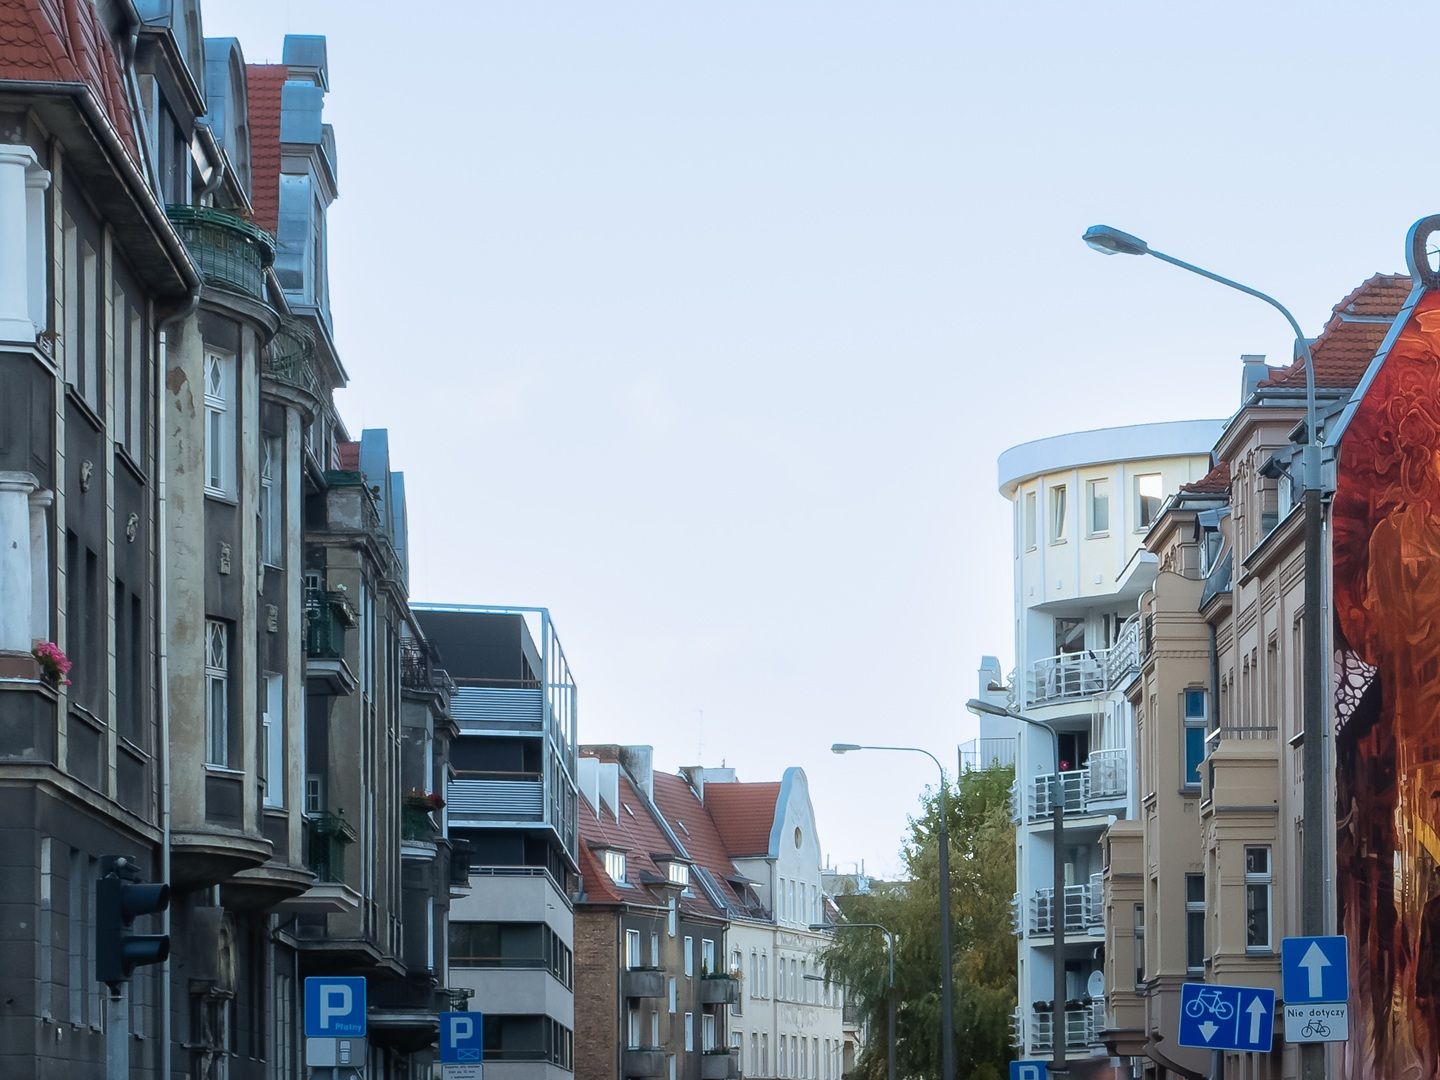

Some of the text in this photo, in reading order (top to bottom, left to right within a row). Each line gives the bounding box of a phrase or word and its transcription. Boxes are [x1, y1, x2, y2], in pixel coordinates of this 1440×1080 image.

[320, 985, 352, 1029] P
[1288, 1008, 1345, 1018] Nie dotyczy
[450, 1017, 473, 1048] P
